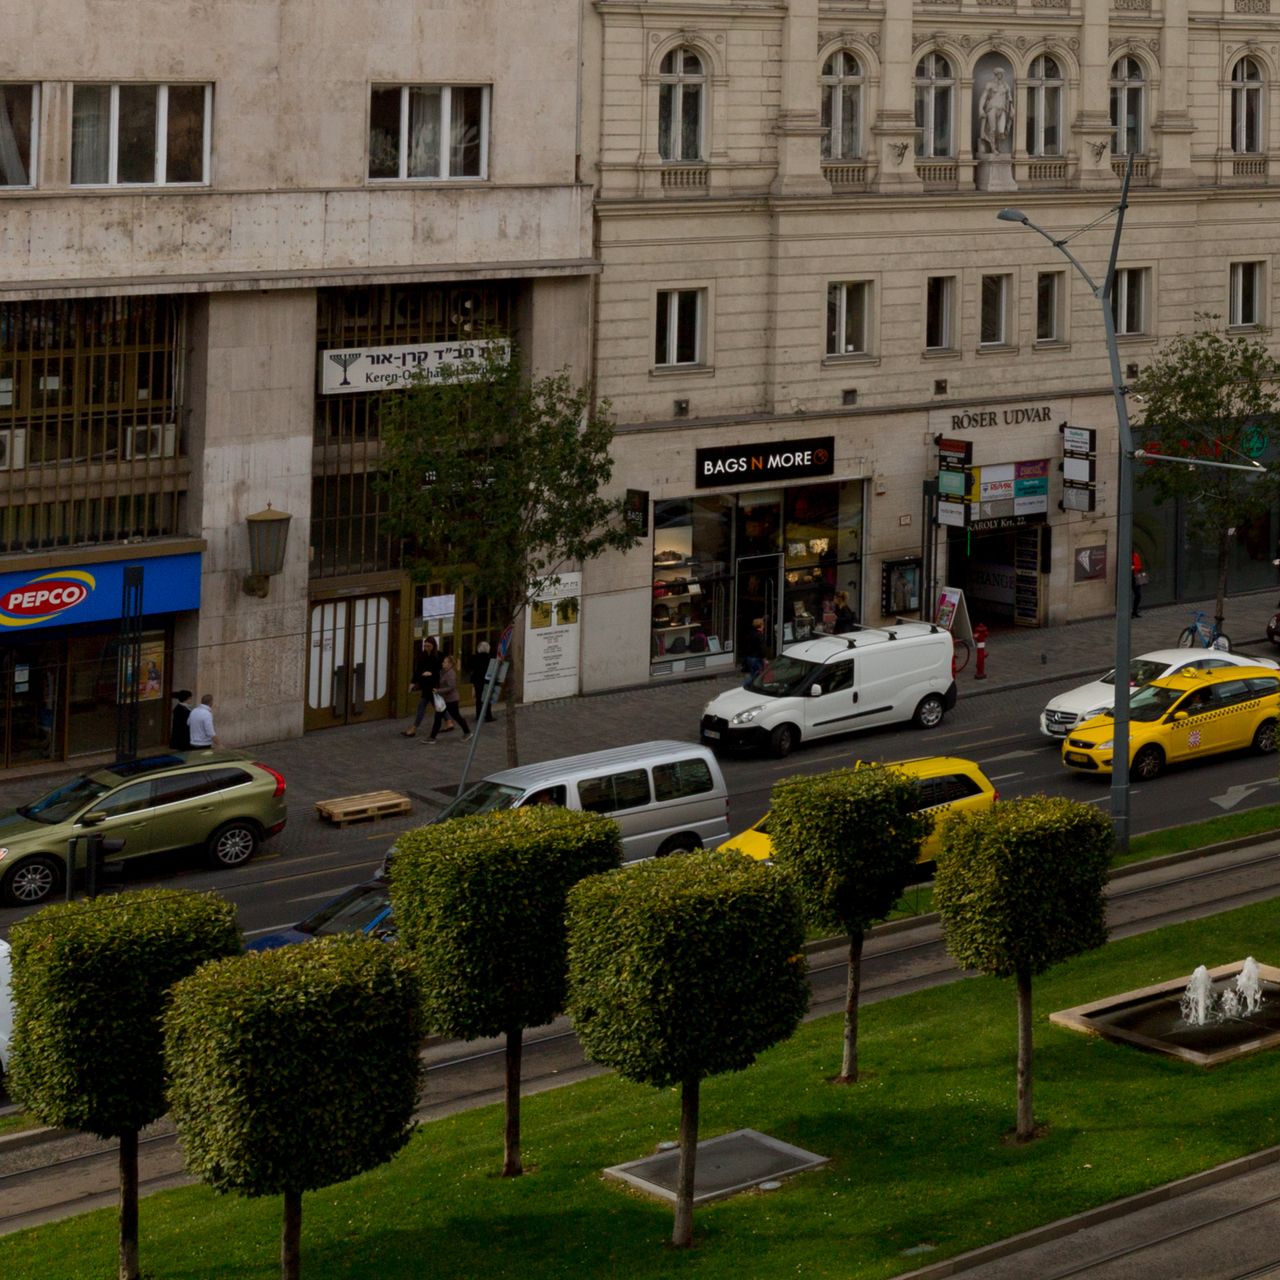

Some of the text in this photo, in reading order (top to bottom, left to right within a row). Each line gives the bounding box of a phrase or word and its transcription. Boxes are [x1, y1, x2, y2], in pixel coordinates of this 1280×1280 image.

[366, 368, 418, 383] Keren-O
[1003, 407, 1051, 425] UDVAR
[703, 450, 812, 475] BAGS N MORE
[8, 586, 81, 610] PEPCO
